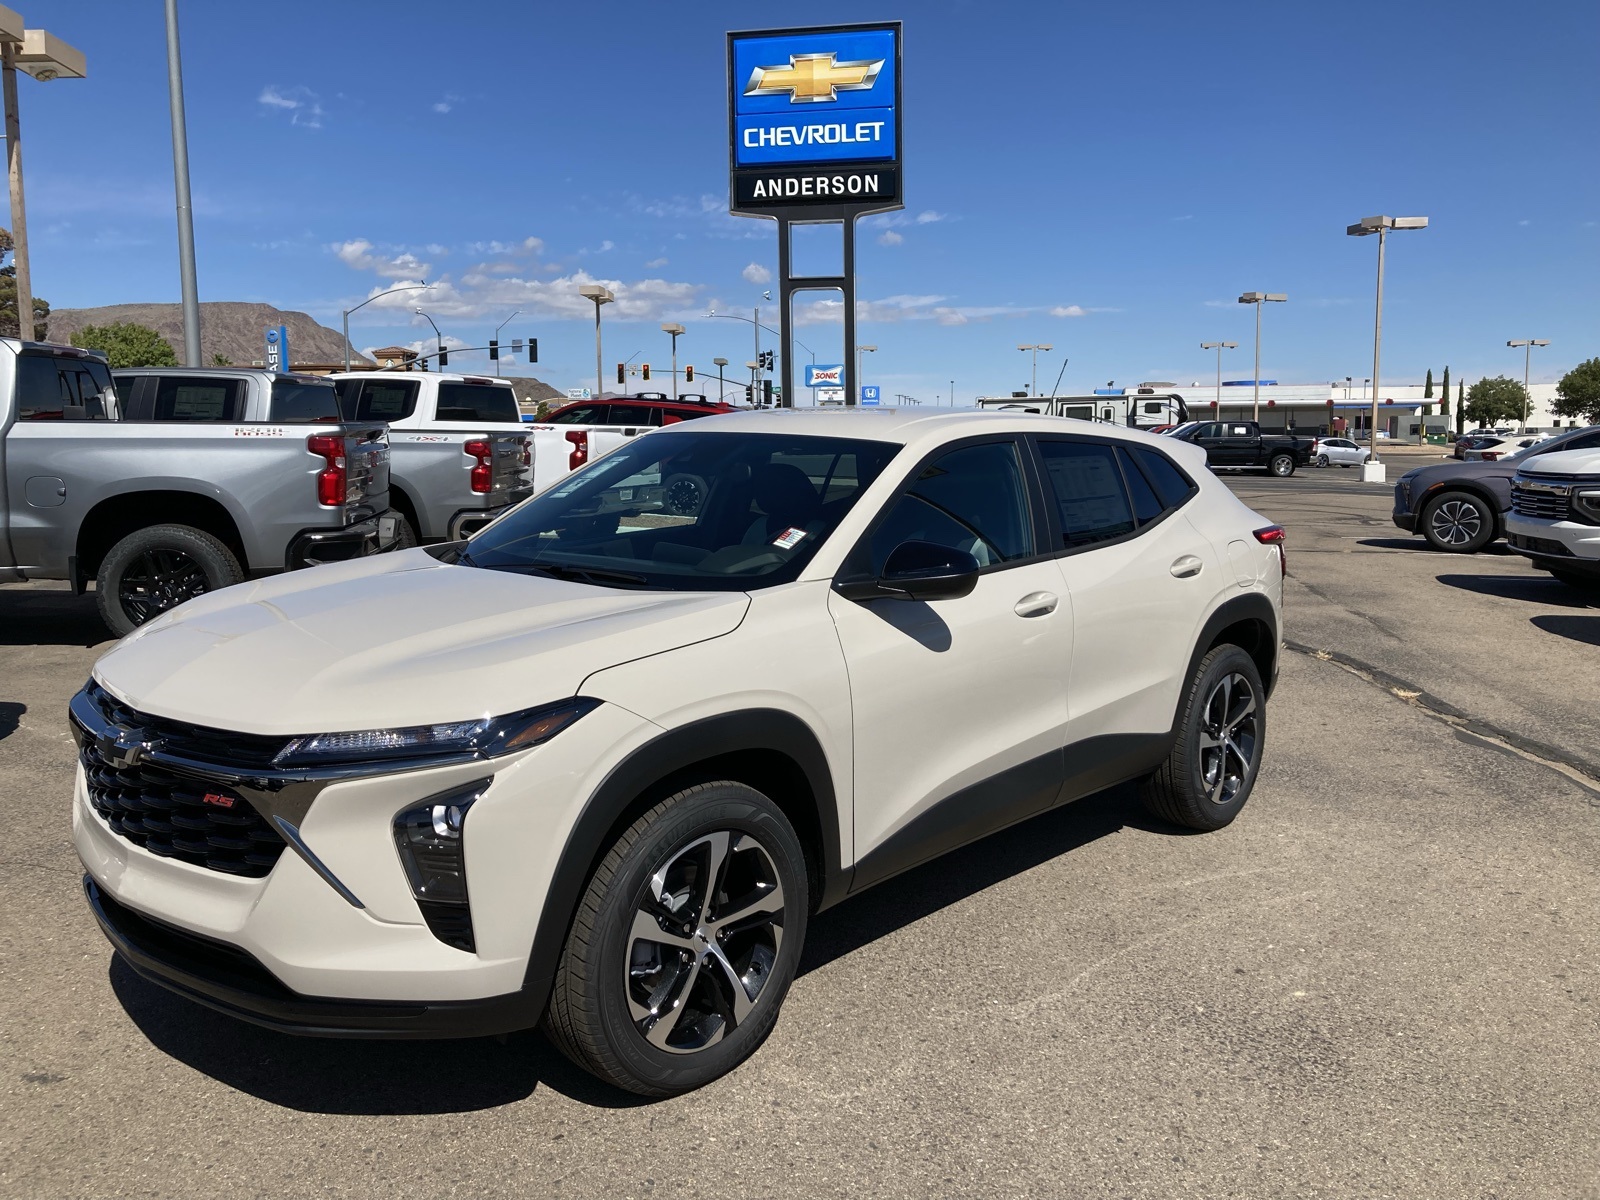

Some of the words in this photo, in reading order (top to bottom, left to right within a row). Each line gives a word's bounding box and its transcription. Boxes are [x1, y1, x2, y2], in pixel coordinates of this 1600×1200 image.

[743, 121, 885, 148] CHEVROLET
[752, 174, 879, 198] ANDERSON
[814, 372, 838, 380] SONIC
[203, 793, 235, 808] RS
